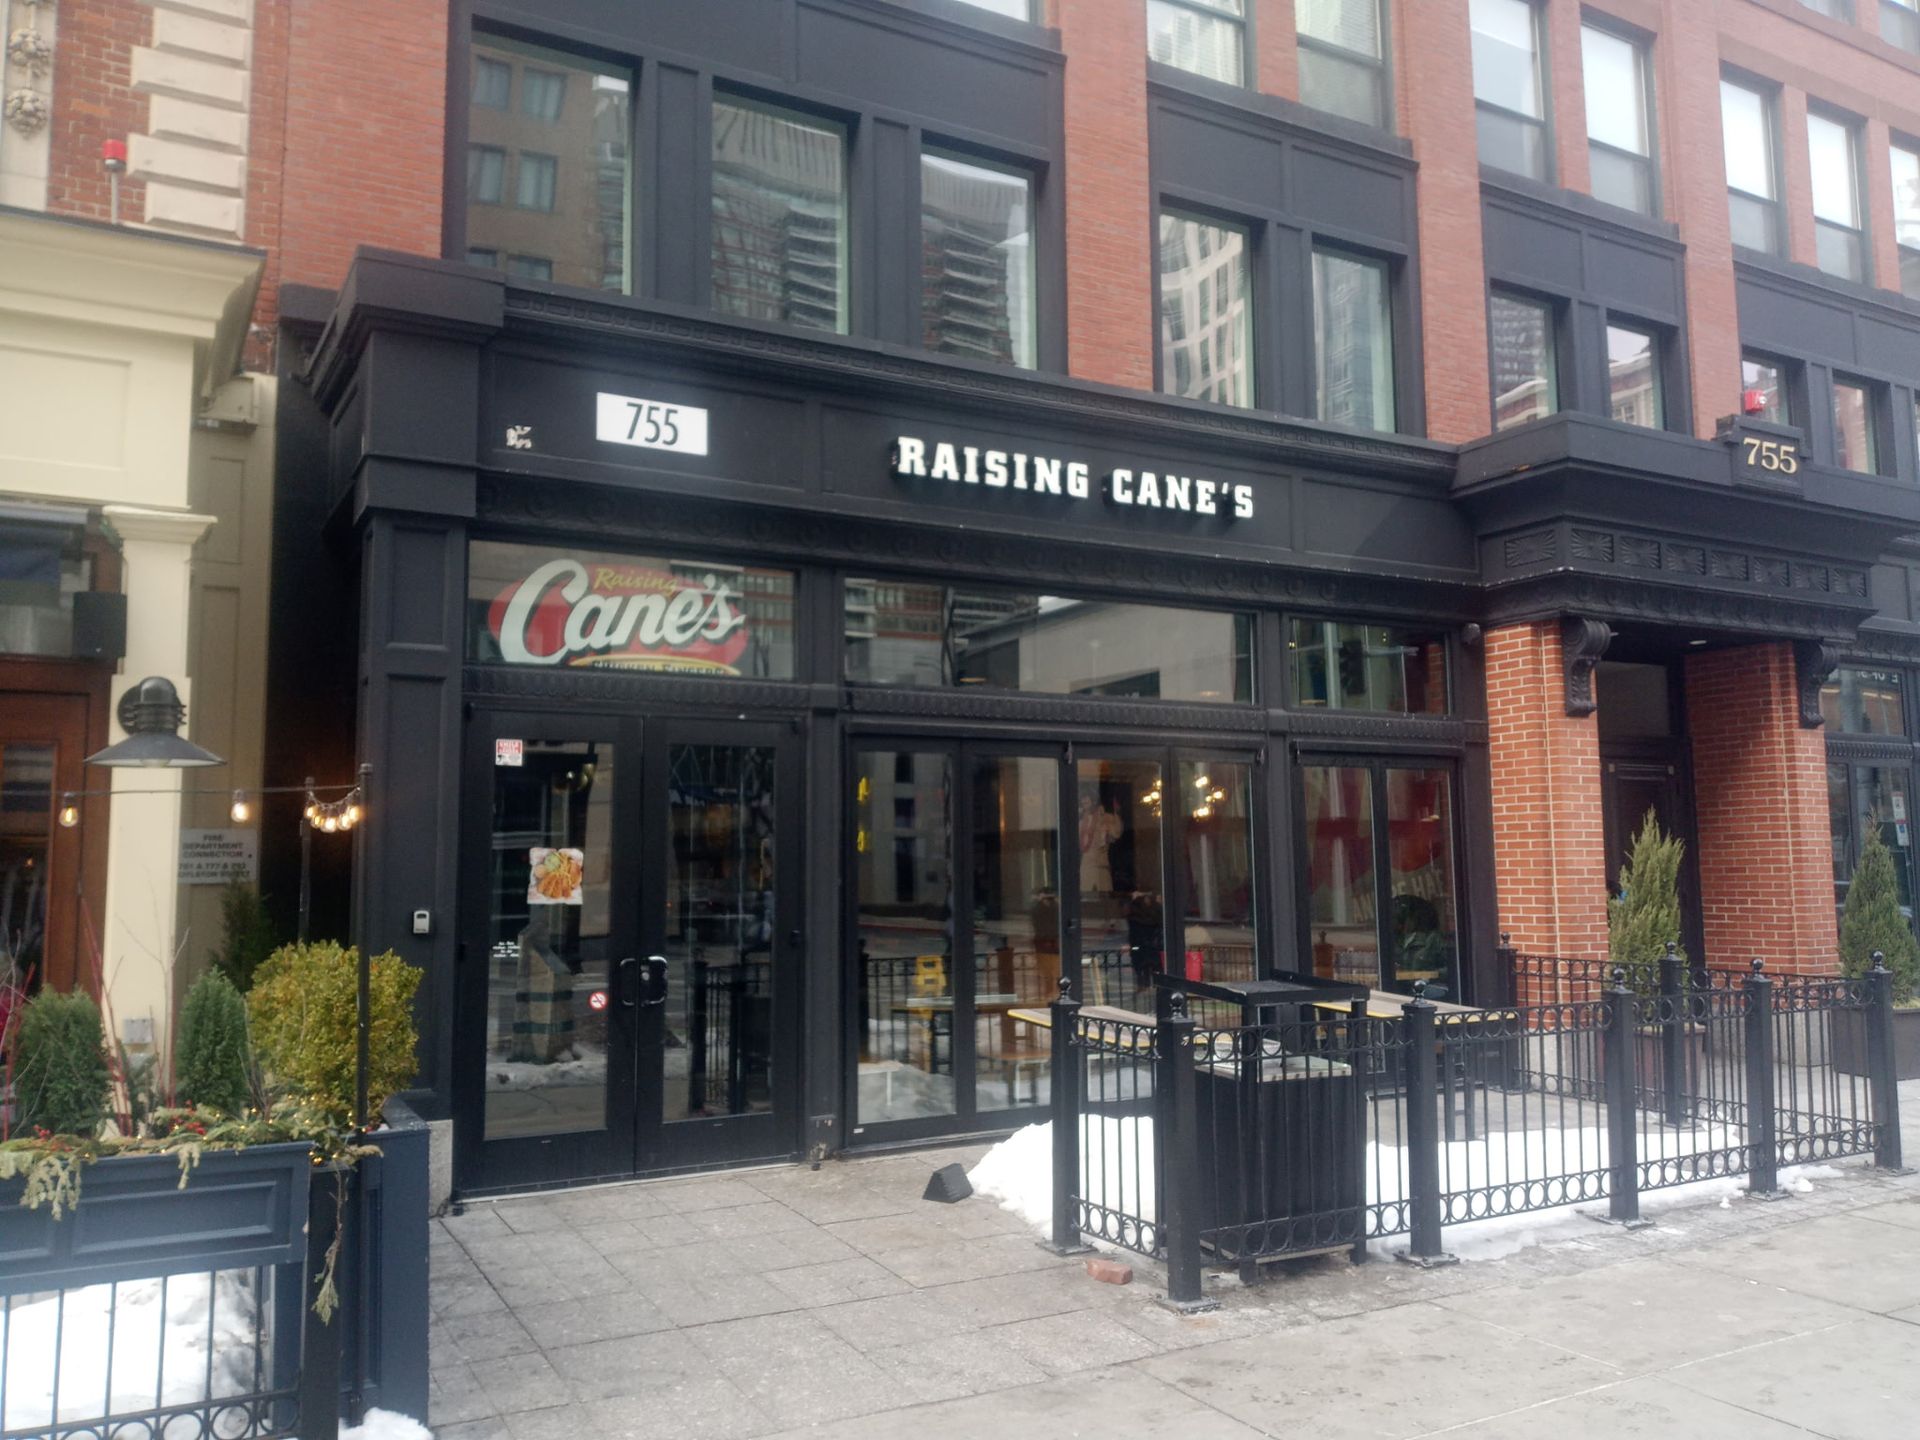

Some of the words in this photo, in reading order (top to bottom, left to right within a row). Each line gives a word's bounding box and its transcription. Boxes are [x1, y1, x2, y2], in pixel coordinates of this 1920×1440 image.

[626, 402, 678, 446] 755
[1743, 437, 1797, 474] 755
[897, 436, 1089, 499] RAISING
[1112, 468, 1254, 519] CANE'S
[593, 567, 677, 598] Raising
[500, 558, 747, 665] Cane's
[182, 842, 243, 850] DEPARTMENT
[182, 850, 243, 858] CONNECTION
